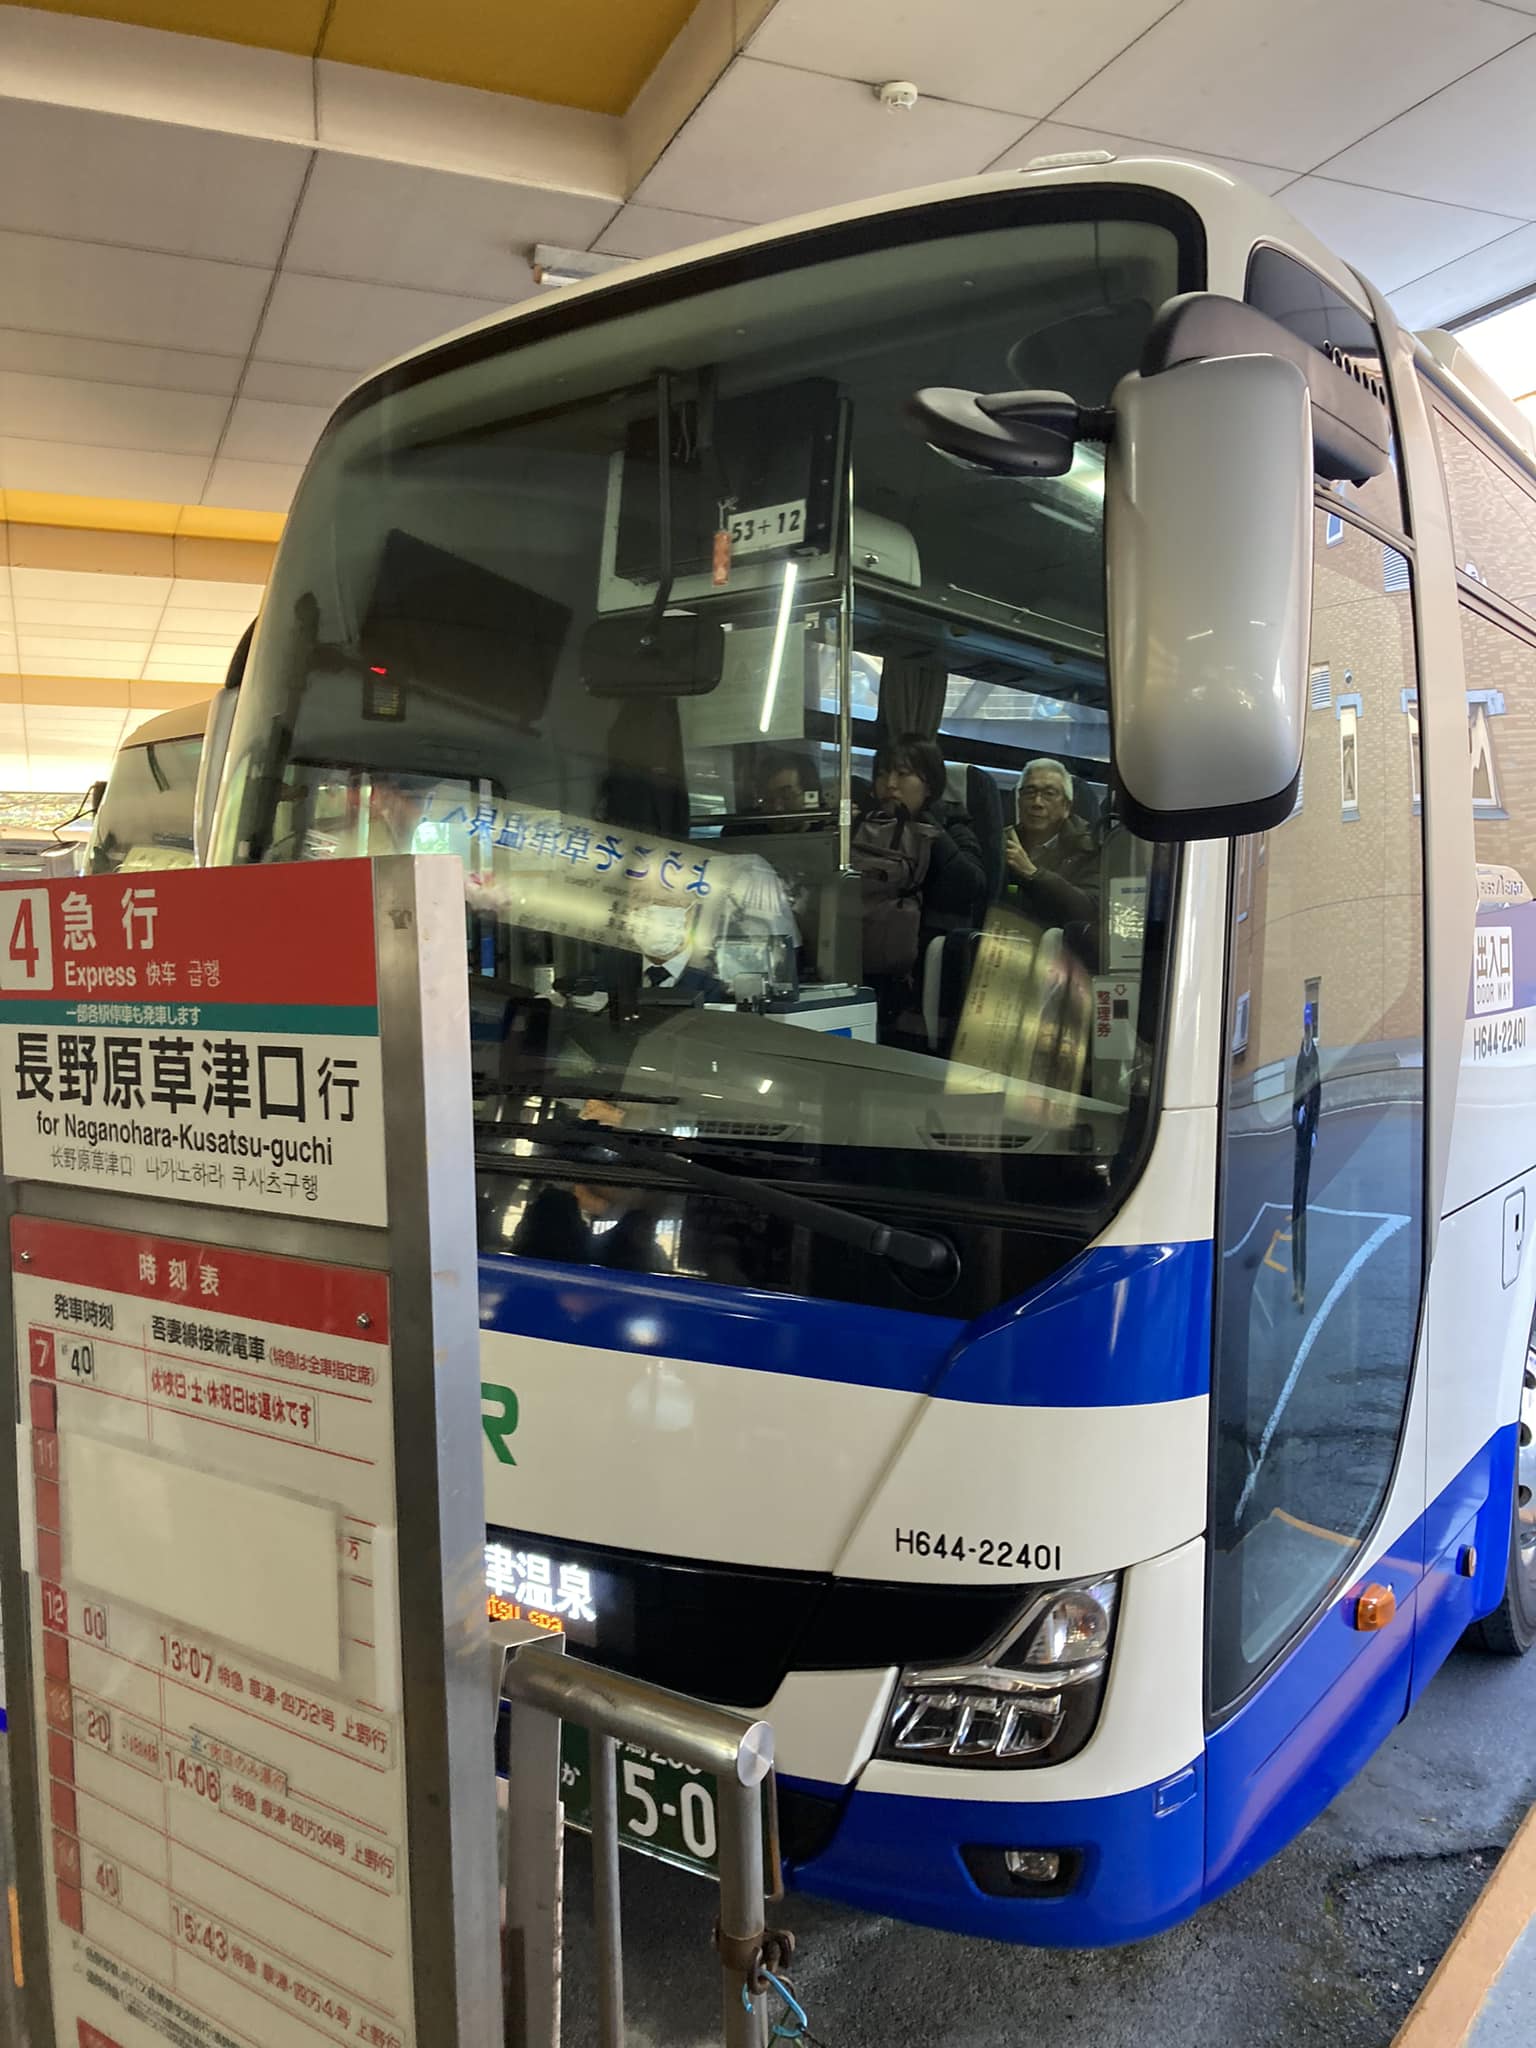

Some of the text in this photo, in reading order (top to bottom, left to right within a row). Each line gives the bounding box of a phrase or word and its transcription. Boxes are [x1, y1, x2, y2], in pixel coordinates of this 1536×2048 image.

[9, 898, 39, 978] 4
[61, 888, 158, 951] 急行
[65, 960, 220, 992] Express 快车 급행
[1477, 935, 1511, 979] 出入口
[1096, 990, 1112, 1038] 整理券
[1476, 982, 1511, 1005] DOOR WAY
[1473, 1016, 1526, 1061] H644-22401
[15, 1032, 360, 1122] 長野原草津口行
[37, 1114, 332, 1166] for Naganohara-Kusatsu-guchi
[50, 1146, 132, 1176] 长野原草津口
[146, 1157, 224, 1188] 나가노하라
[138, 1253, 219, 1297] 時刻表
[54, 1294, 114, 1331] 発車時刻
[35, 1339, 91, 1376] 7 40
[151, 1315, 265, 1363] 吾妻線接続電車
[480, 1382, 519, 1466] R
[896, 1527, 1061, 1571] H644-22401
[46, 1592, 106, 1640] 12 00
[160, 1634, 212, 1683] 13:07
[87, 1710, 110, 1743] 20
[165, 1750, 220, 1803] 14:06
[561, 1761, 581, 1786] か
[172, 1905, 227, 1962] 15:43
